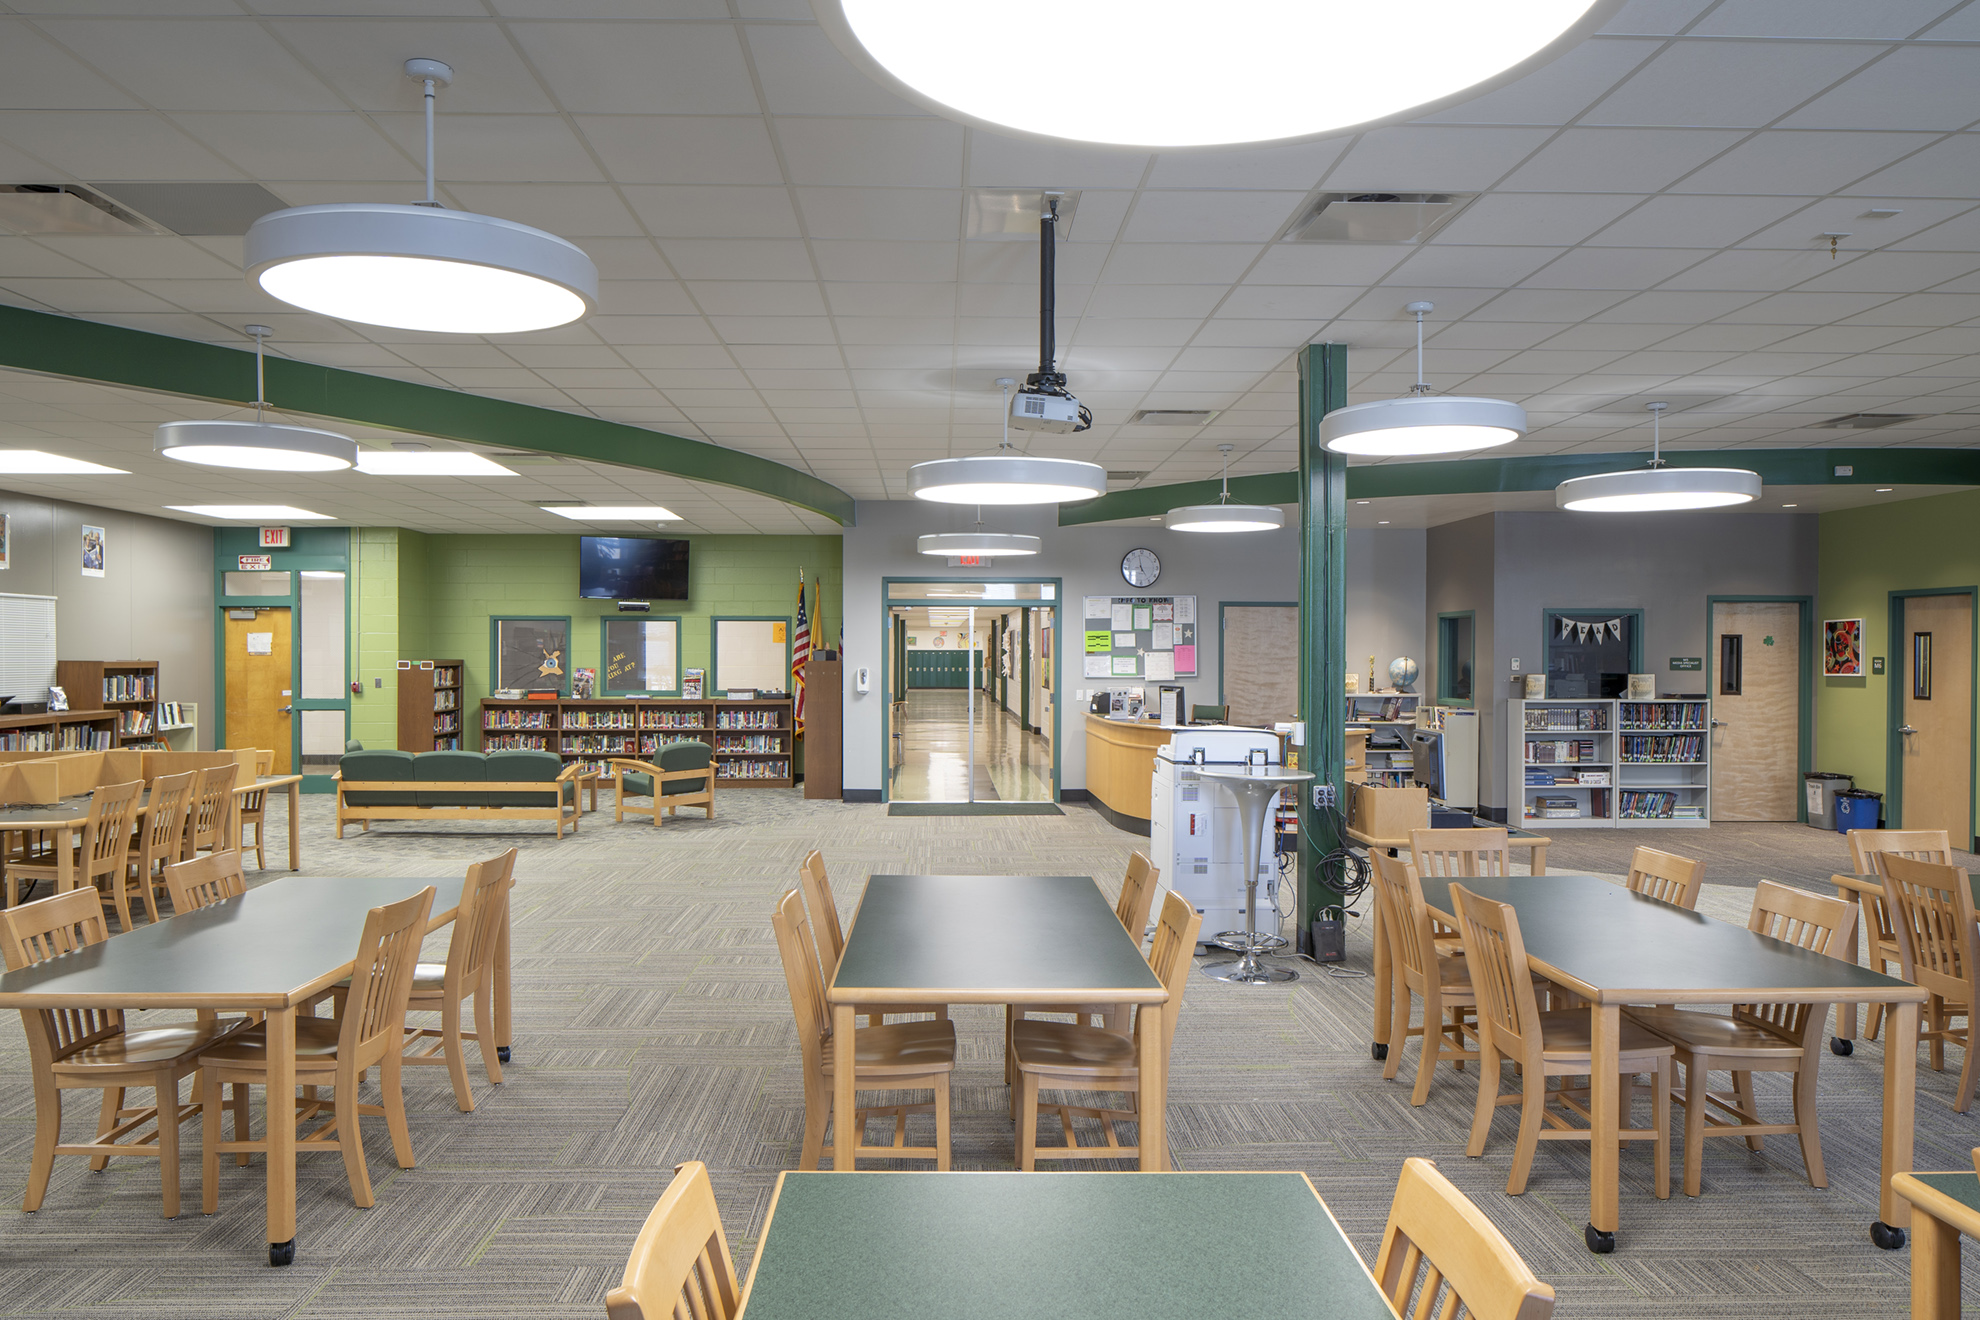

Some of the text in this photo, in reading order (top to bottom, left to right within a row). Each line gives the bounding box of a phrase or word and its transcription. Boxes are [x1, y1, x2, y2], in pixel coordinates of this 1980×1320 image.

[264, 530, 284, 544] EXIT
[1563, 623, 1619, 635] READ
[613, 652, 626, 662] ARE
[624, 662, 636, 672] AT?
